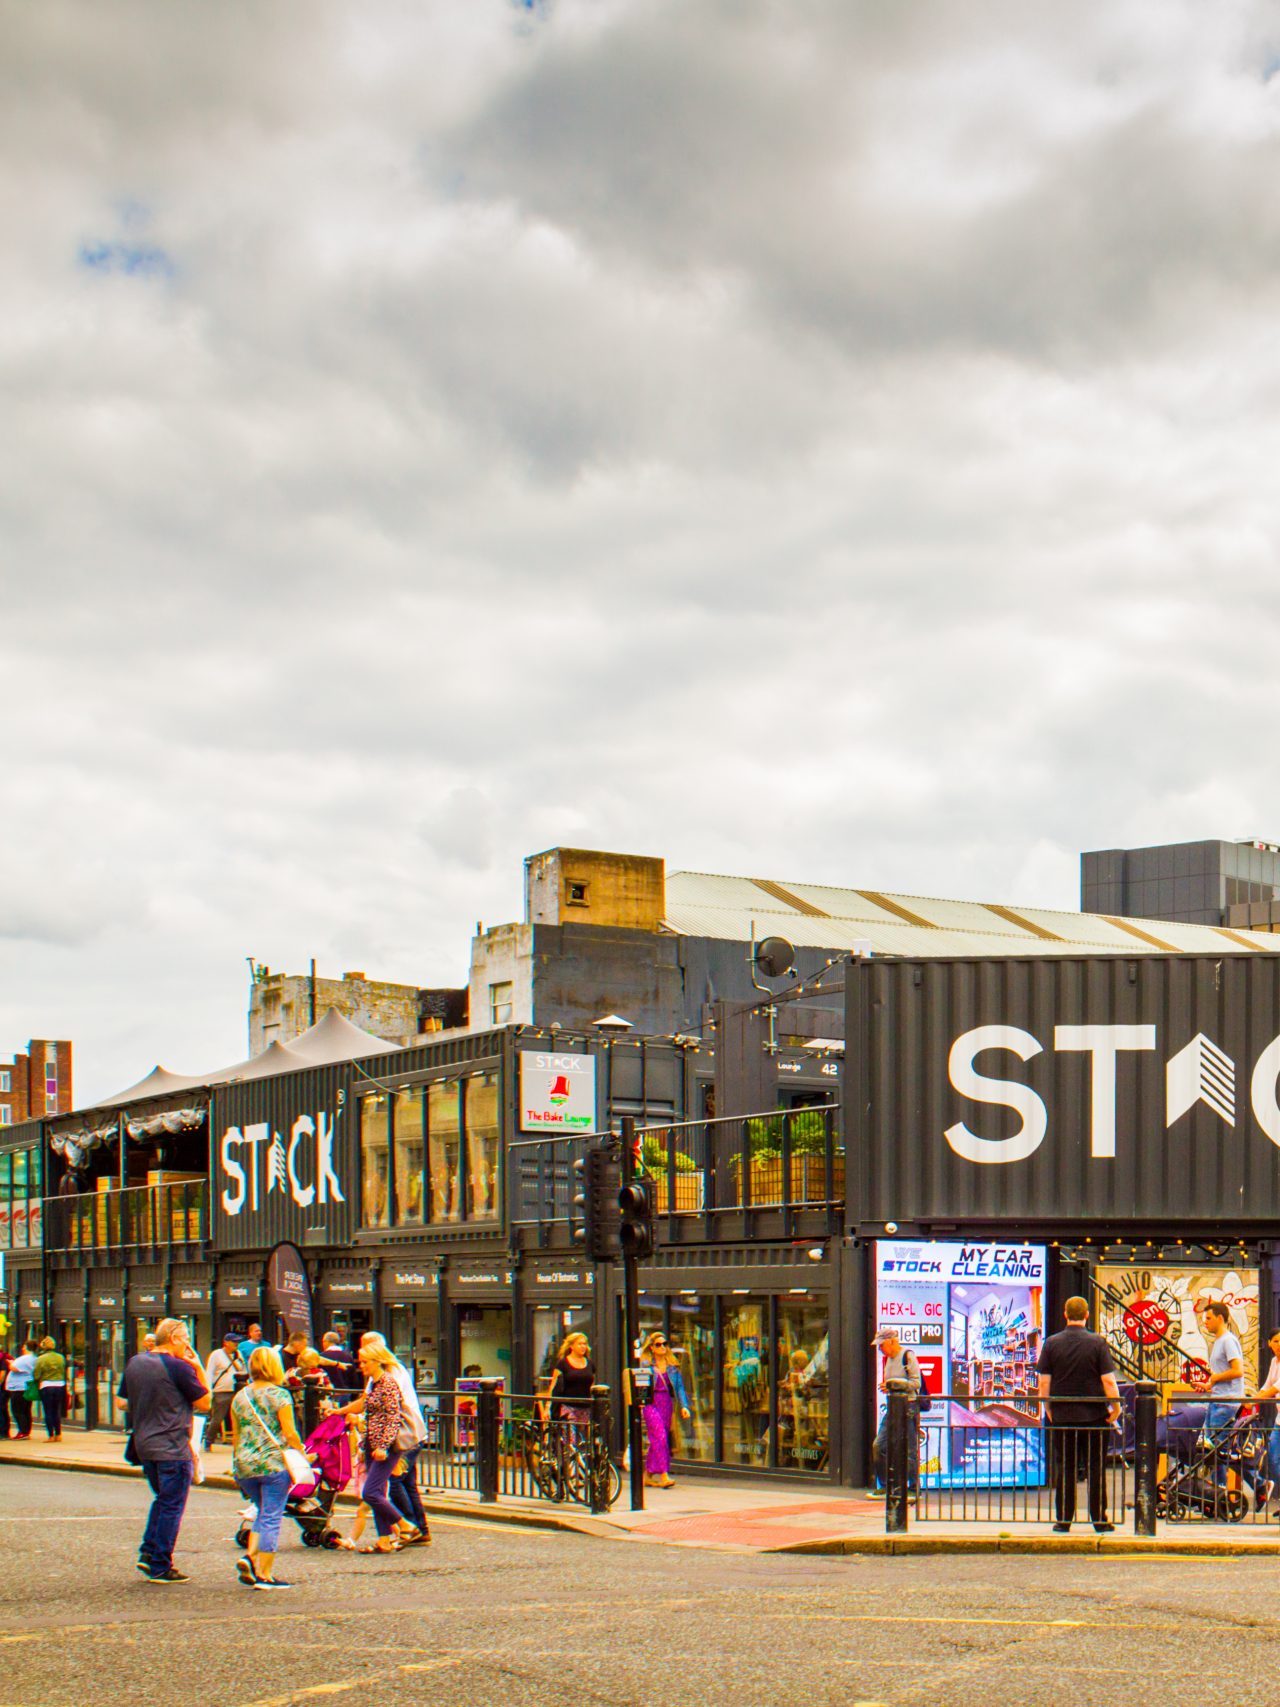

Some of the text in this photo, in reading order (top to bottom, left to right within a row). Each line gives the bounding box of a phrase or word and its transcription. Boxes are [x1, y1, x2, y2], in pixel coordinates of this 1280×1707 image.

[822, 1064, 838, 1075] 42
[527, 1110, 542, 1120] The
[543, 1111, 563, 1122] Bake
[894, 1247, 922, 1259] WE
[959, 1248, 1033, 1263] MY CAR
[882, 1261, 942, 1273] STOCK
[951, 1263, 1043, 1278] CLEANING
[585, 1272, 595, 1284] 16
[921, 1325, 941, 1337] PRO
